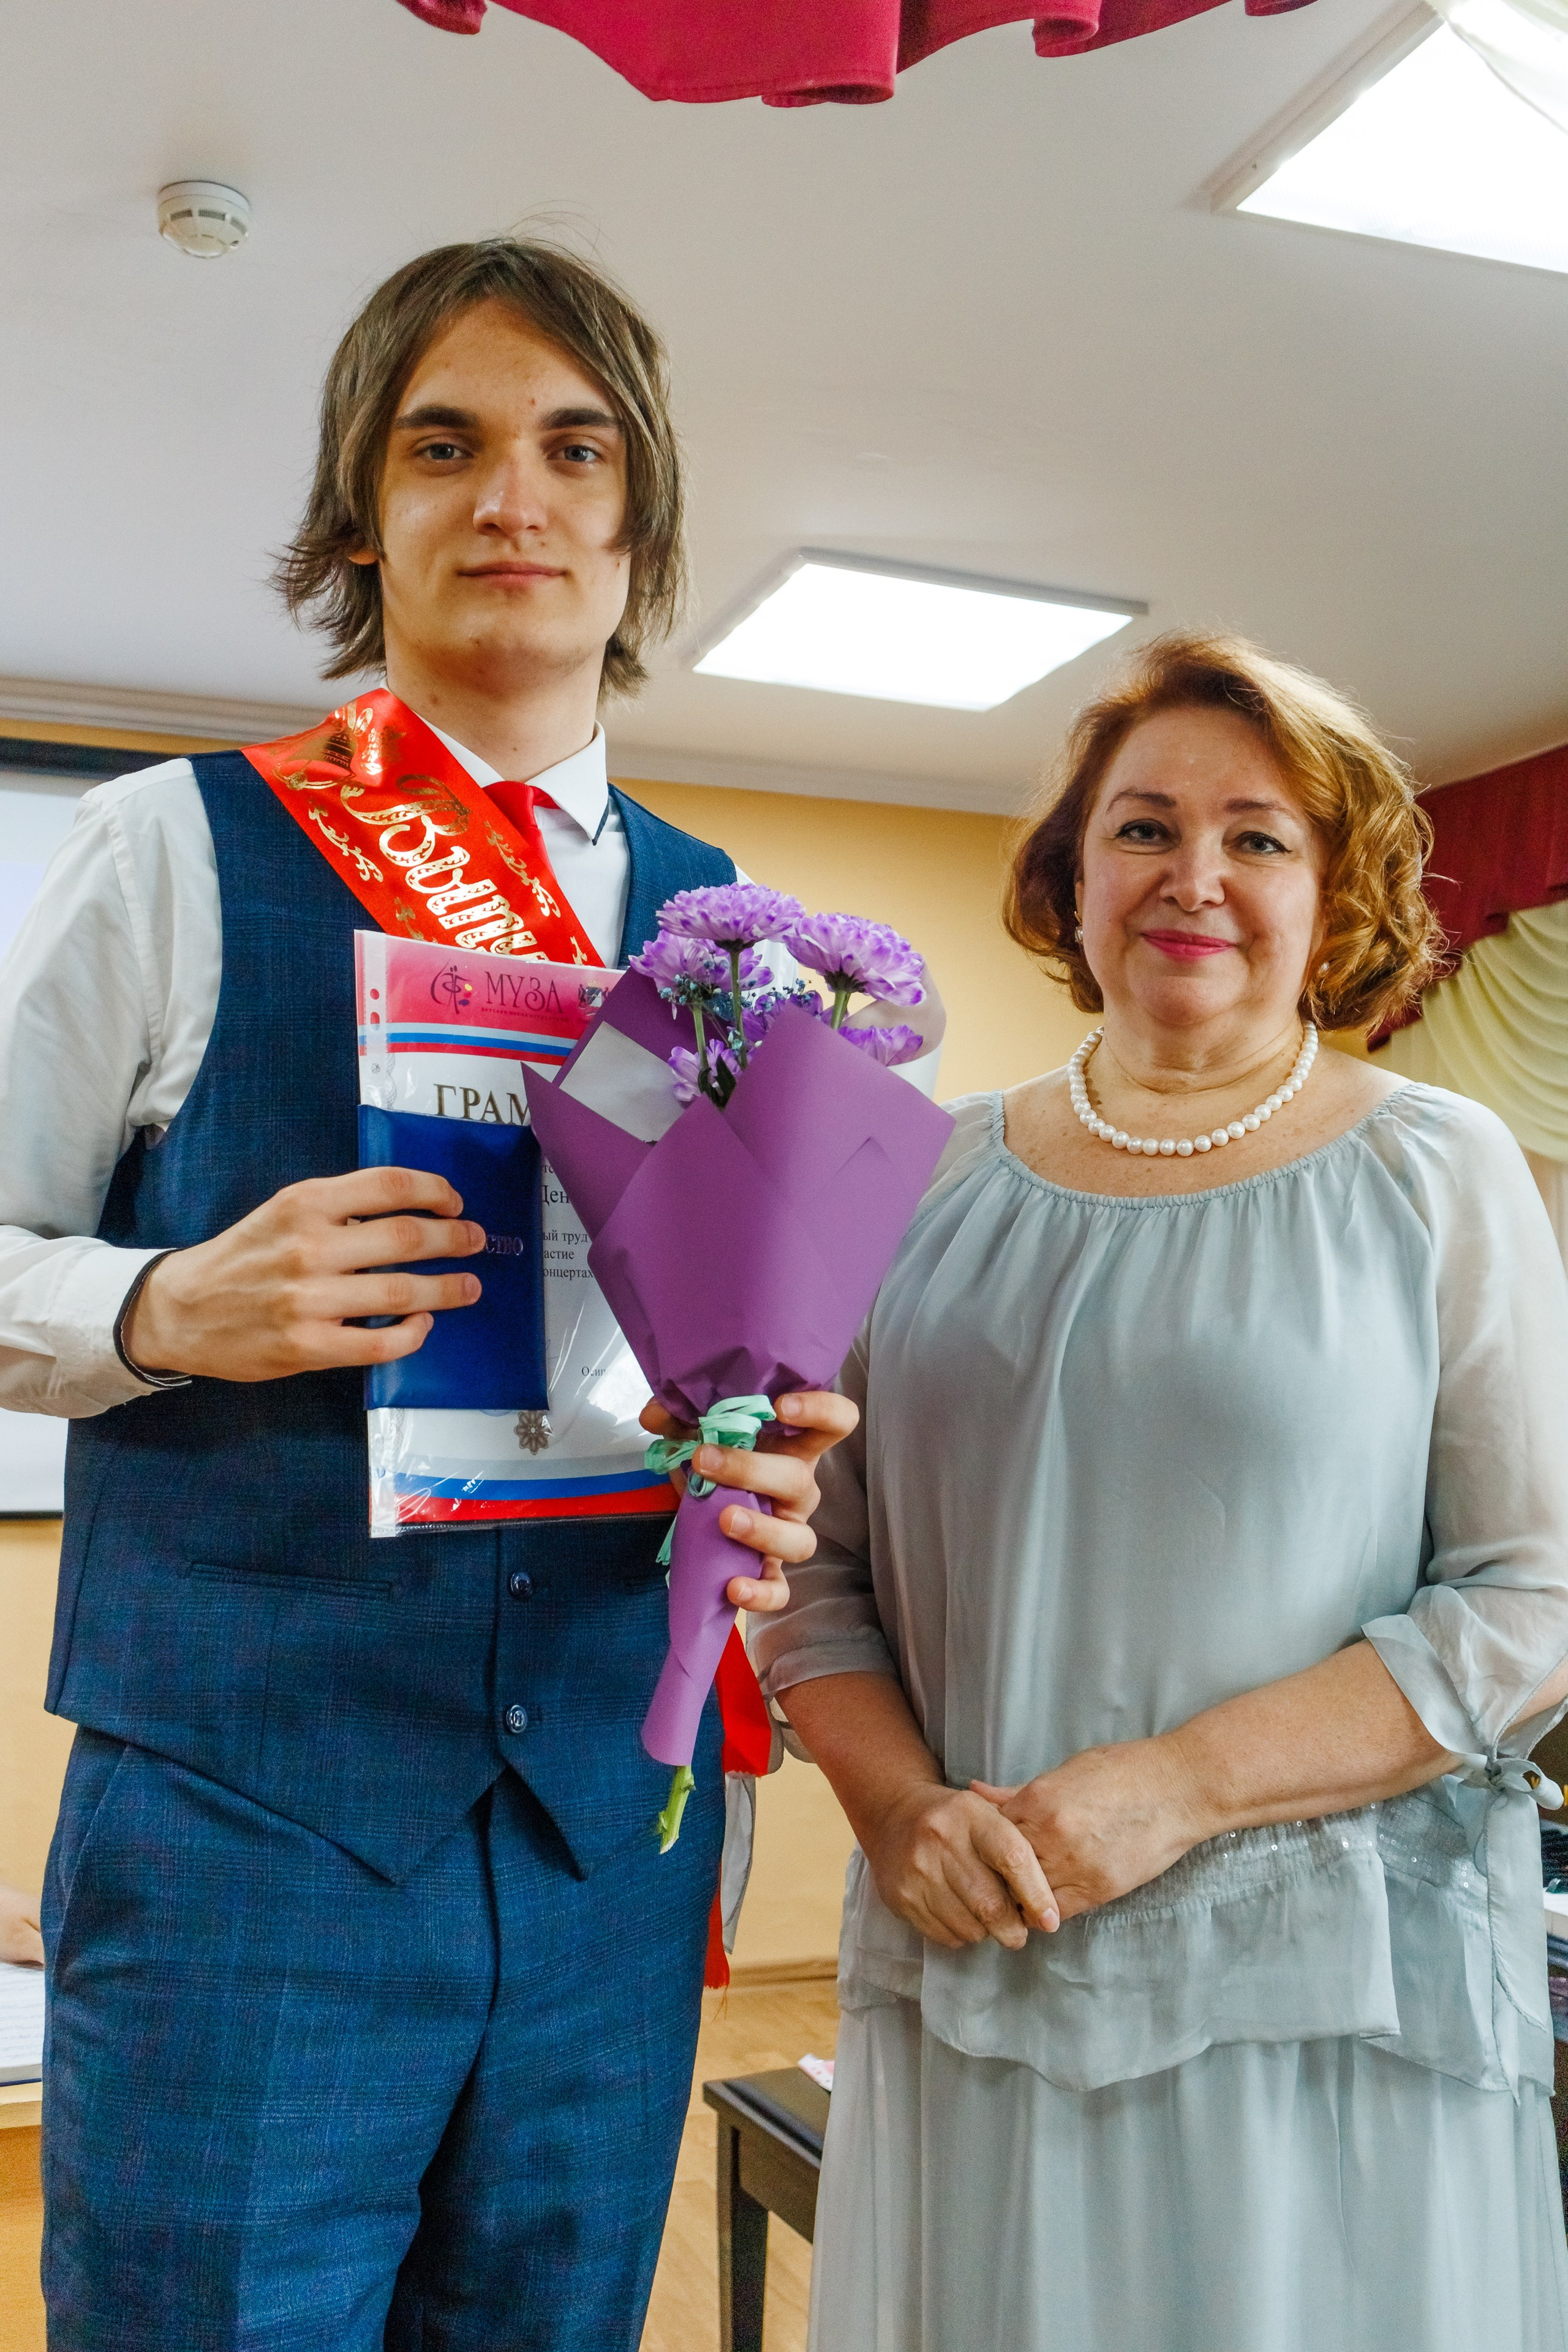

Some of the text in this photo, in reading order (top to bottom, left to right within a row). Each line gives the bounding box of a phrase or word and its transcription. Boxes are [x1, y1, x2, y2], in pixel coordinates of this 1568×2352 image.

[484, 971, 564, 1014] МУЗА
[562, 1233, 588, 1245] труд
[544, 1250, 575, 1260] астие
